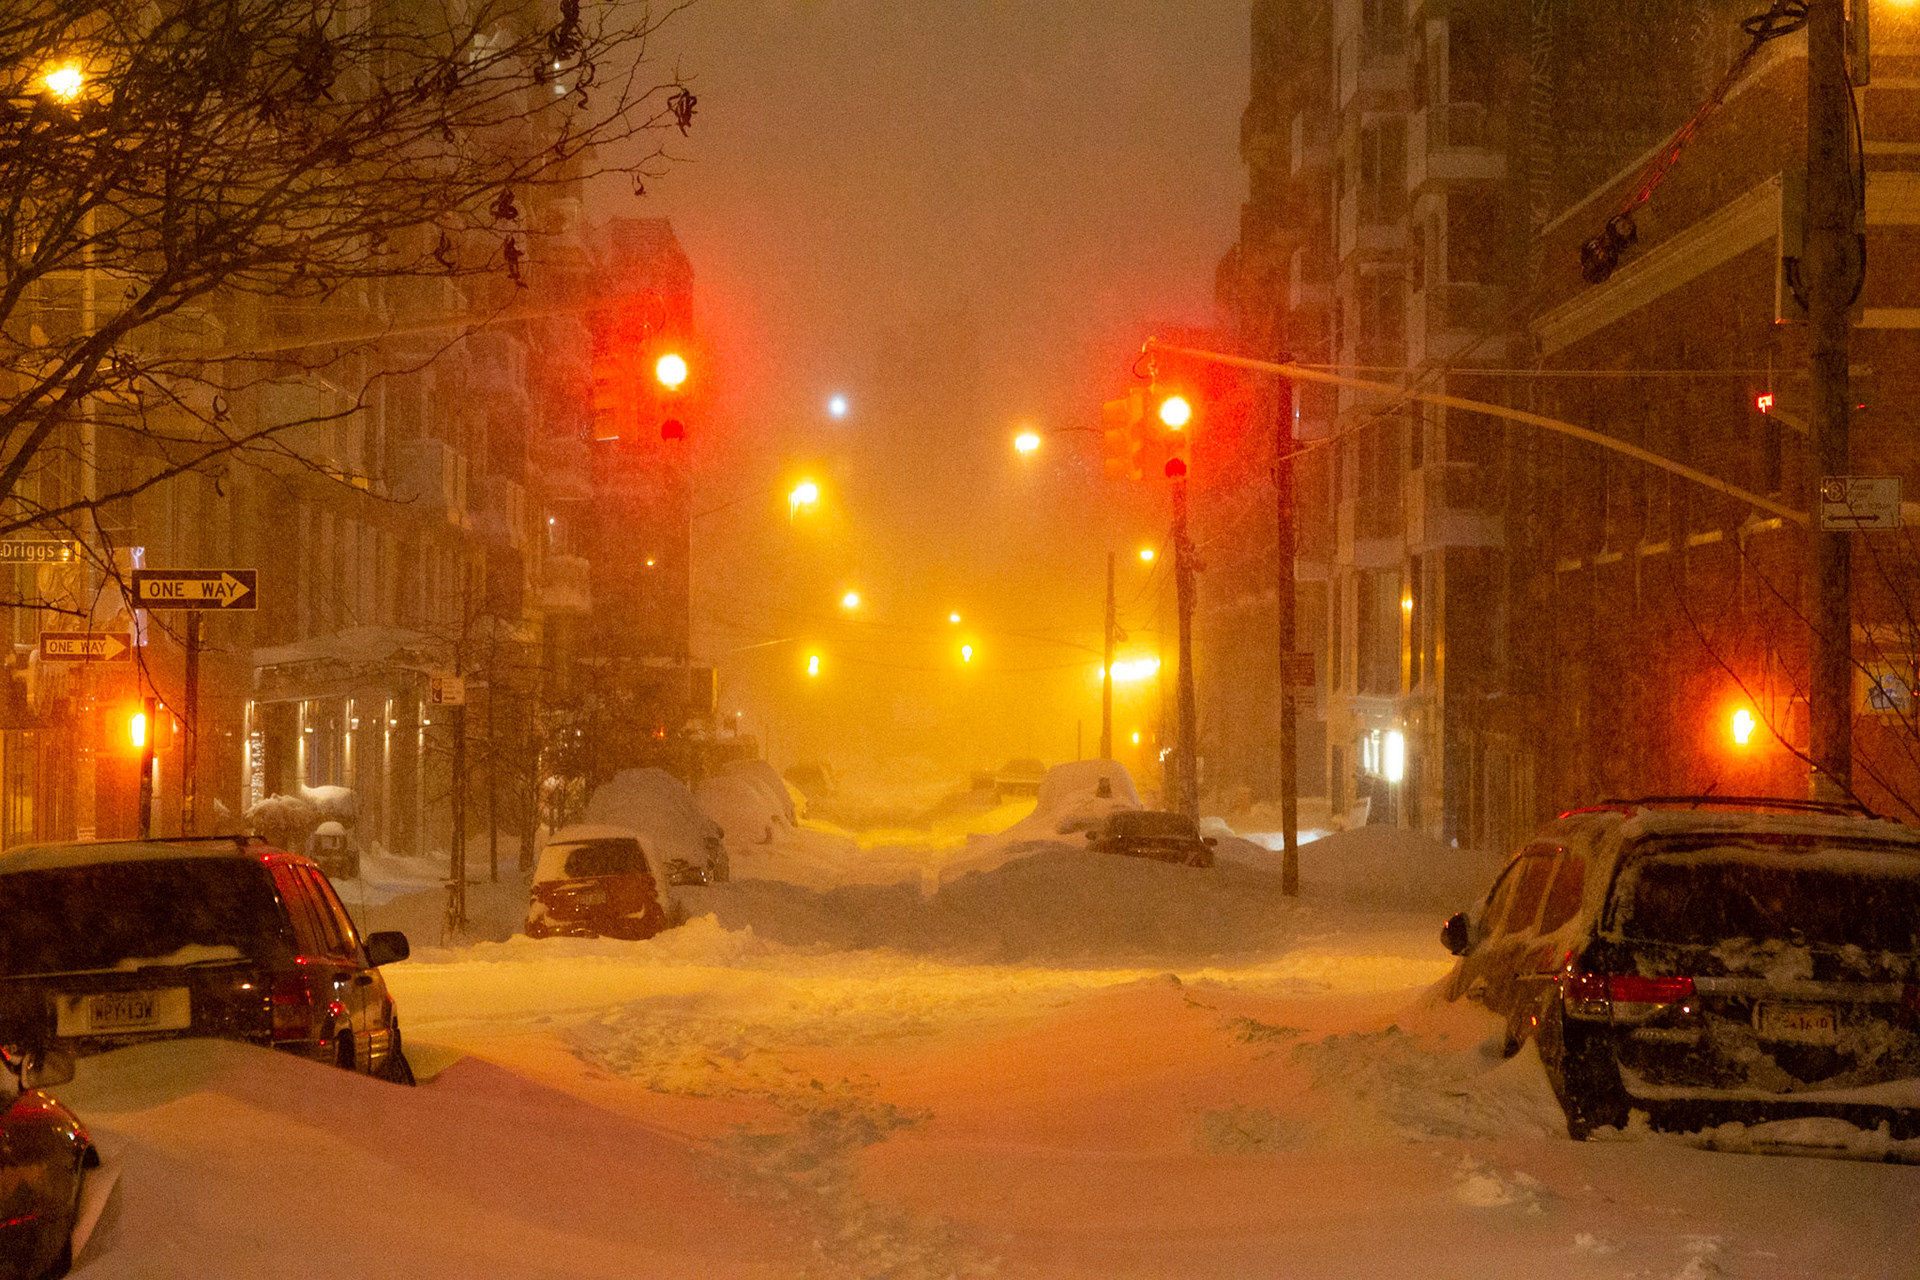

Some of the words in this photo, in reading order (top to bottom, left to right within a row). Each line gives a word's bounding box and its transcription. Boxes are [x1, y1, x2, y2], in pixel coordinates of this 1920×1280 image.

[3, 542, 55, 561] Driggs
[149, 582, 185, 597] ONE
[201, 582, 238, 597] WAY
[49, 641, 74, 653] ONE
[80, 641, 106, 653] WAY
